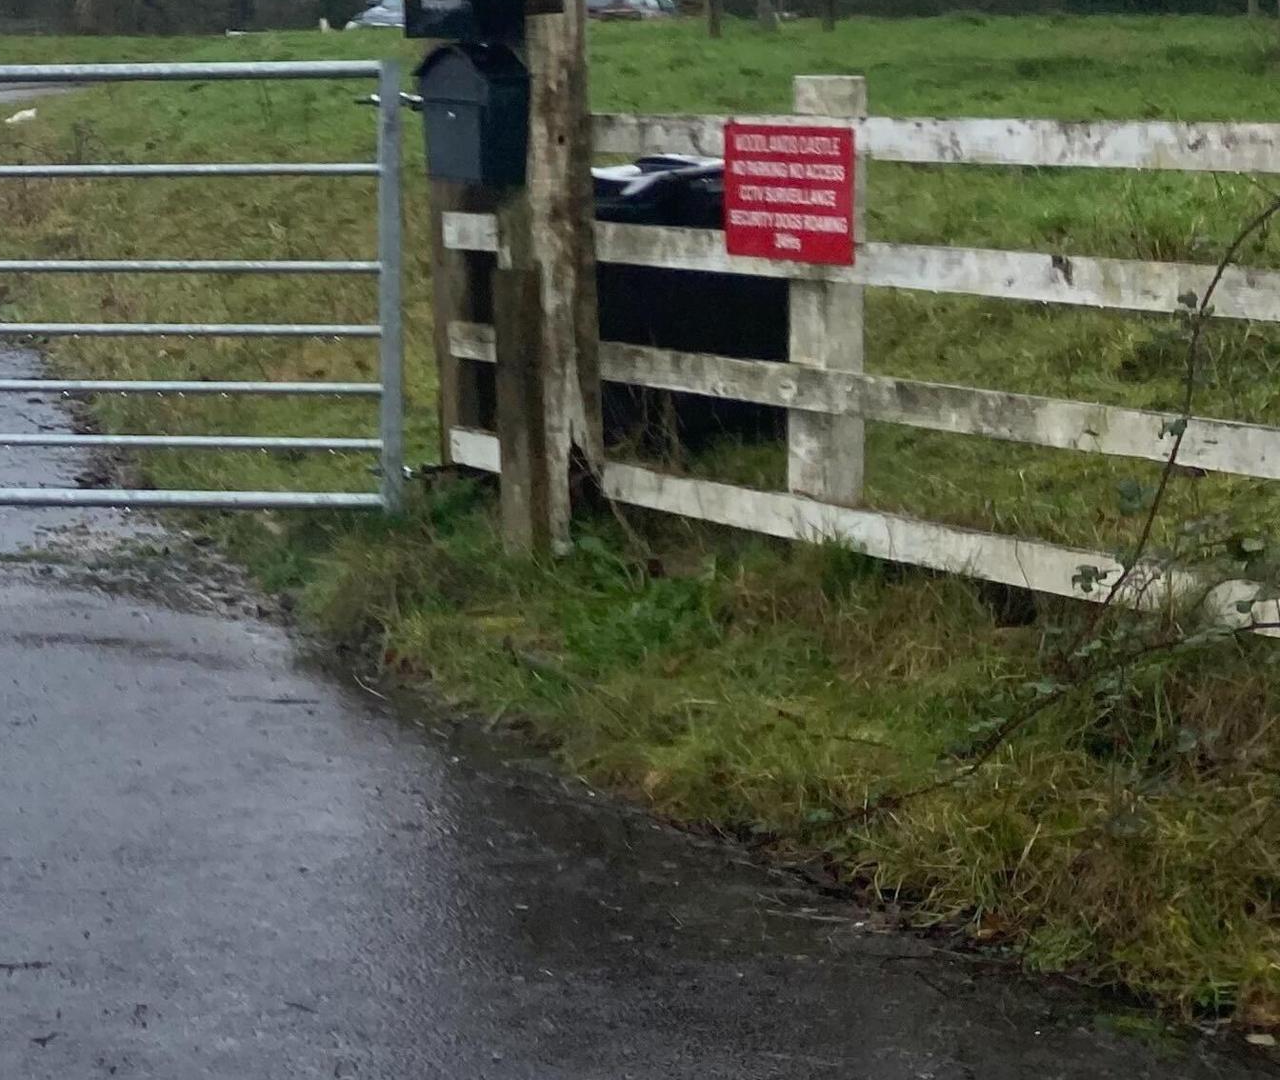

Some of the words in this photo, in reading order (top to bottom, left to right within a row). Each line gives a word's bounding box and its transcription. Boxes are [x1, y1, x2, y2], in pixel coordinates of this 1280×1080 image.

[747, 160, 788, 178] PARKING
[789, 162, 804, 179] NO
[806, 163, 845, 182] ACCESS
[739, 184, 764, 201] CCTV
[765, 186, 836, 208] SURVEILLANCE
[729, 209, 774, 228] SECURITY
[804, 214, 848, 234] ROAMING
